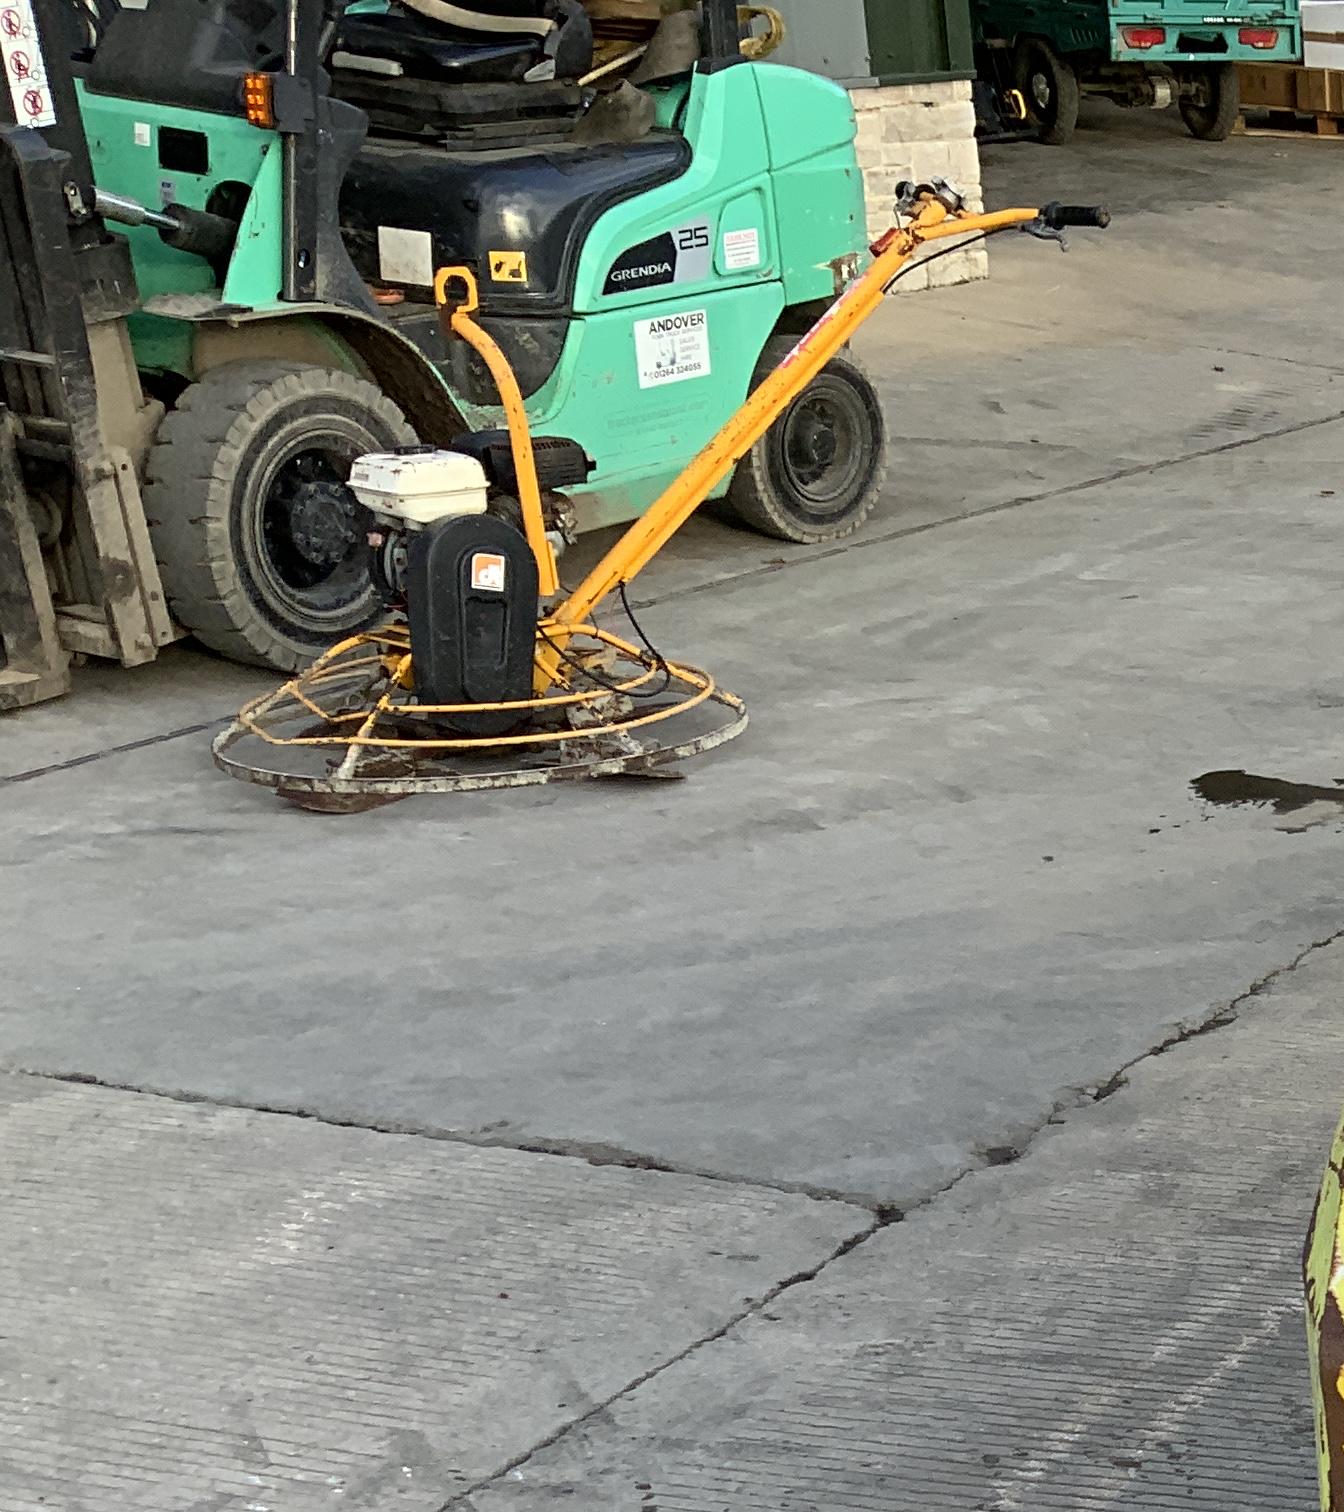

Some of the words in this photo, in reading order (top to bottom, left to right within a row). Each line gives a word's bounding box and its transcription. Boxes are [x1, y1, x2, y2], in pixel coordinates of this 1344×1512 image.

[678, 226, 709, 250] 25
[610, 262, 672, 281] GRENDIA
[649, 313, 704, 334] ANDOVER
